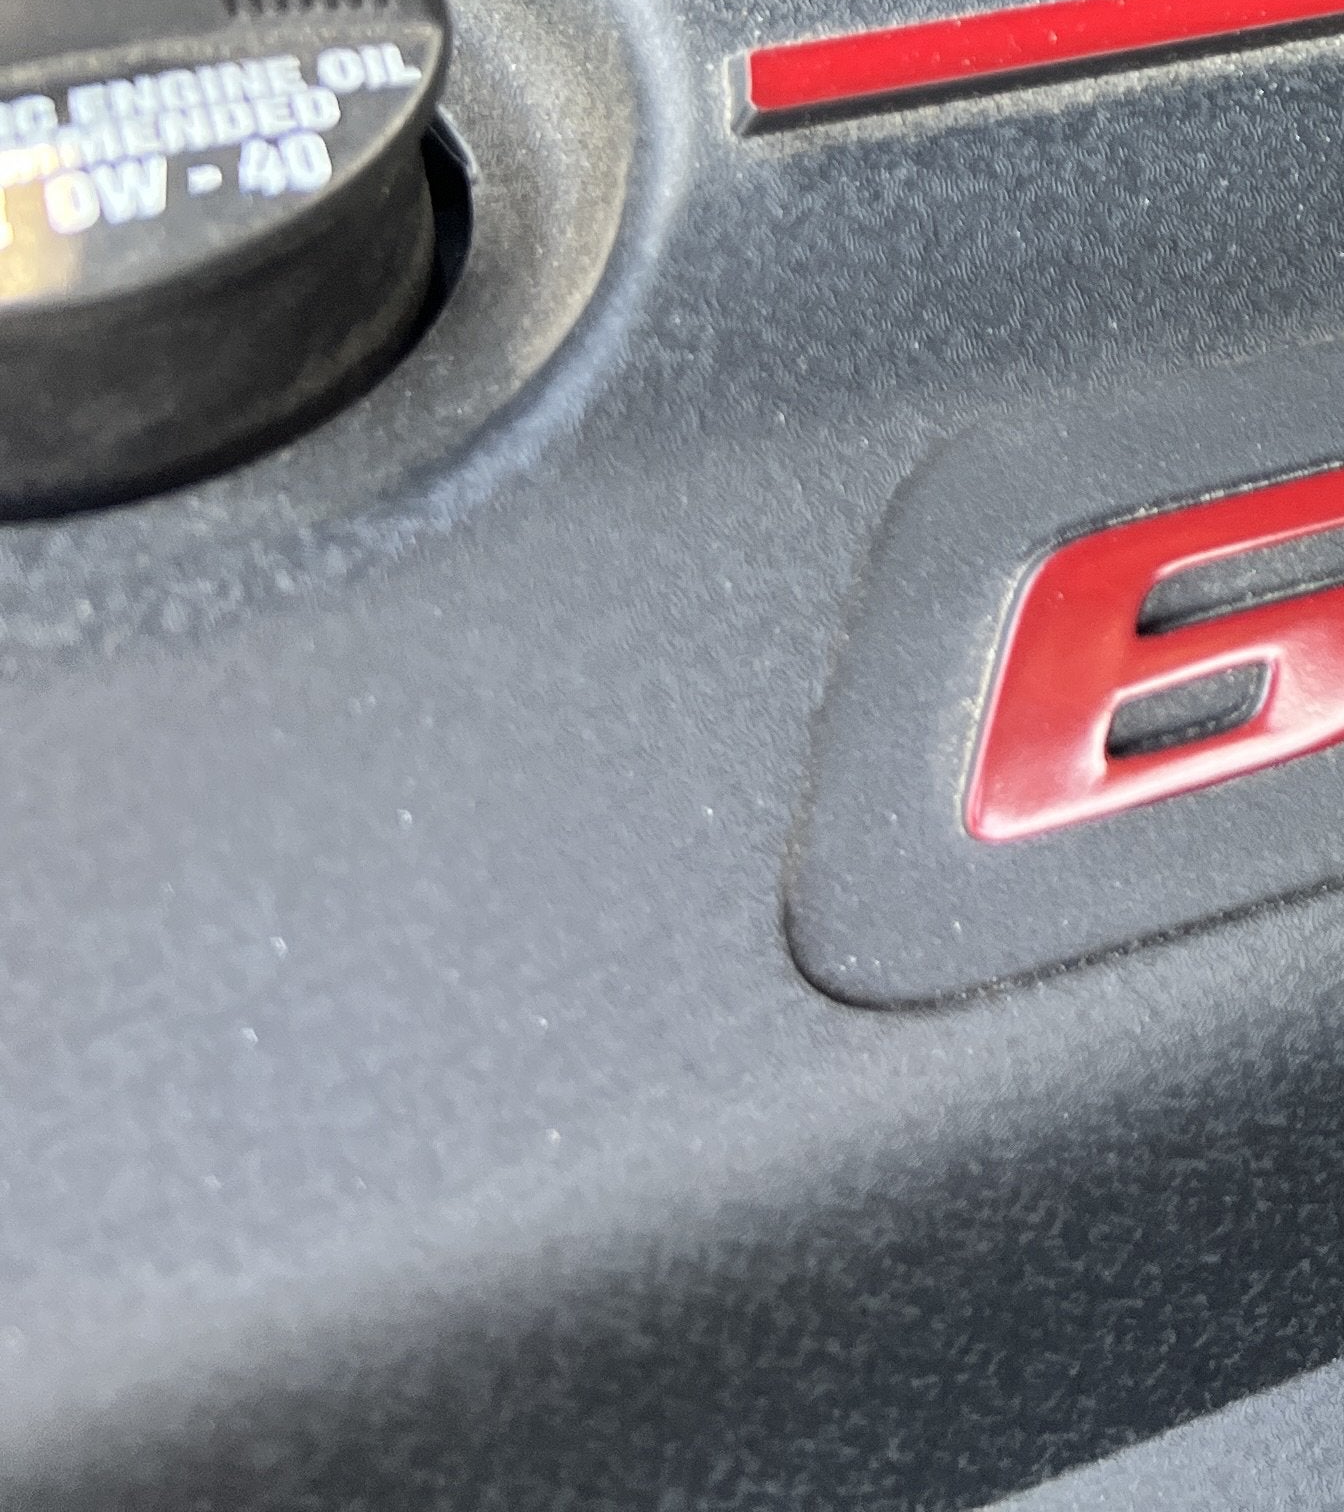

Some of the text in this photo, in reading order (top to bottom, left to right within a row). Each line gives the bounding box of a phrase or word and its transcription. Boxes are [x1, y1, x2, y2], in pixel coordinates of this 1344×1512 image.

[68, 55, 305, 126] ENGINE
[317, 43, 422, 93] OIL
[239, 131, 332, 197] 40
